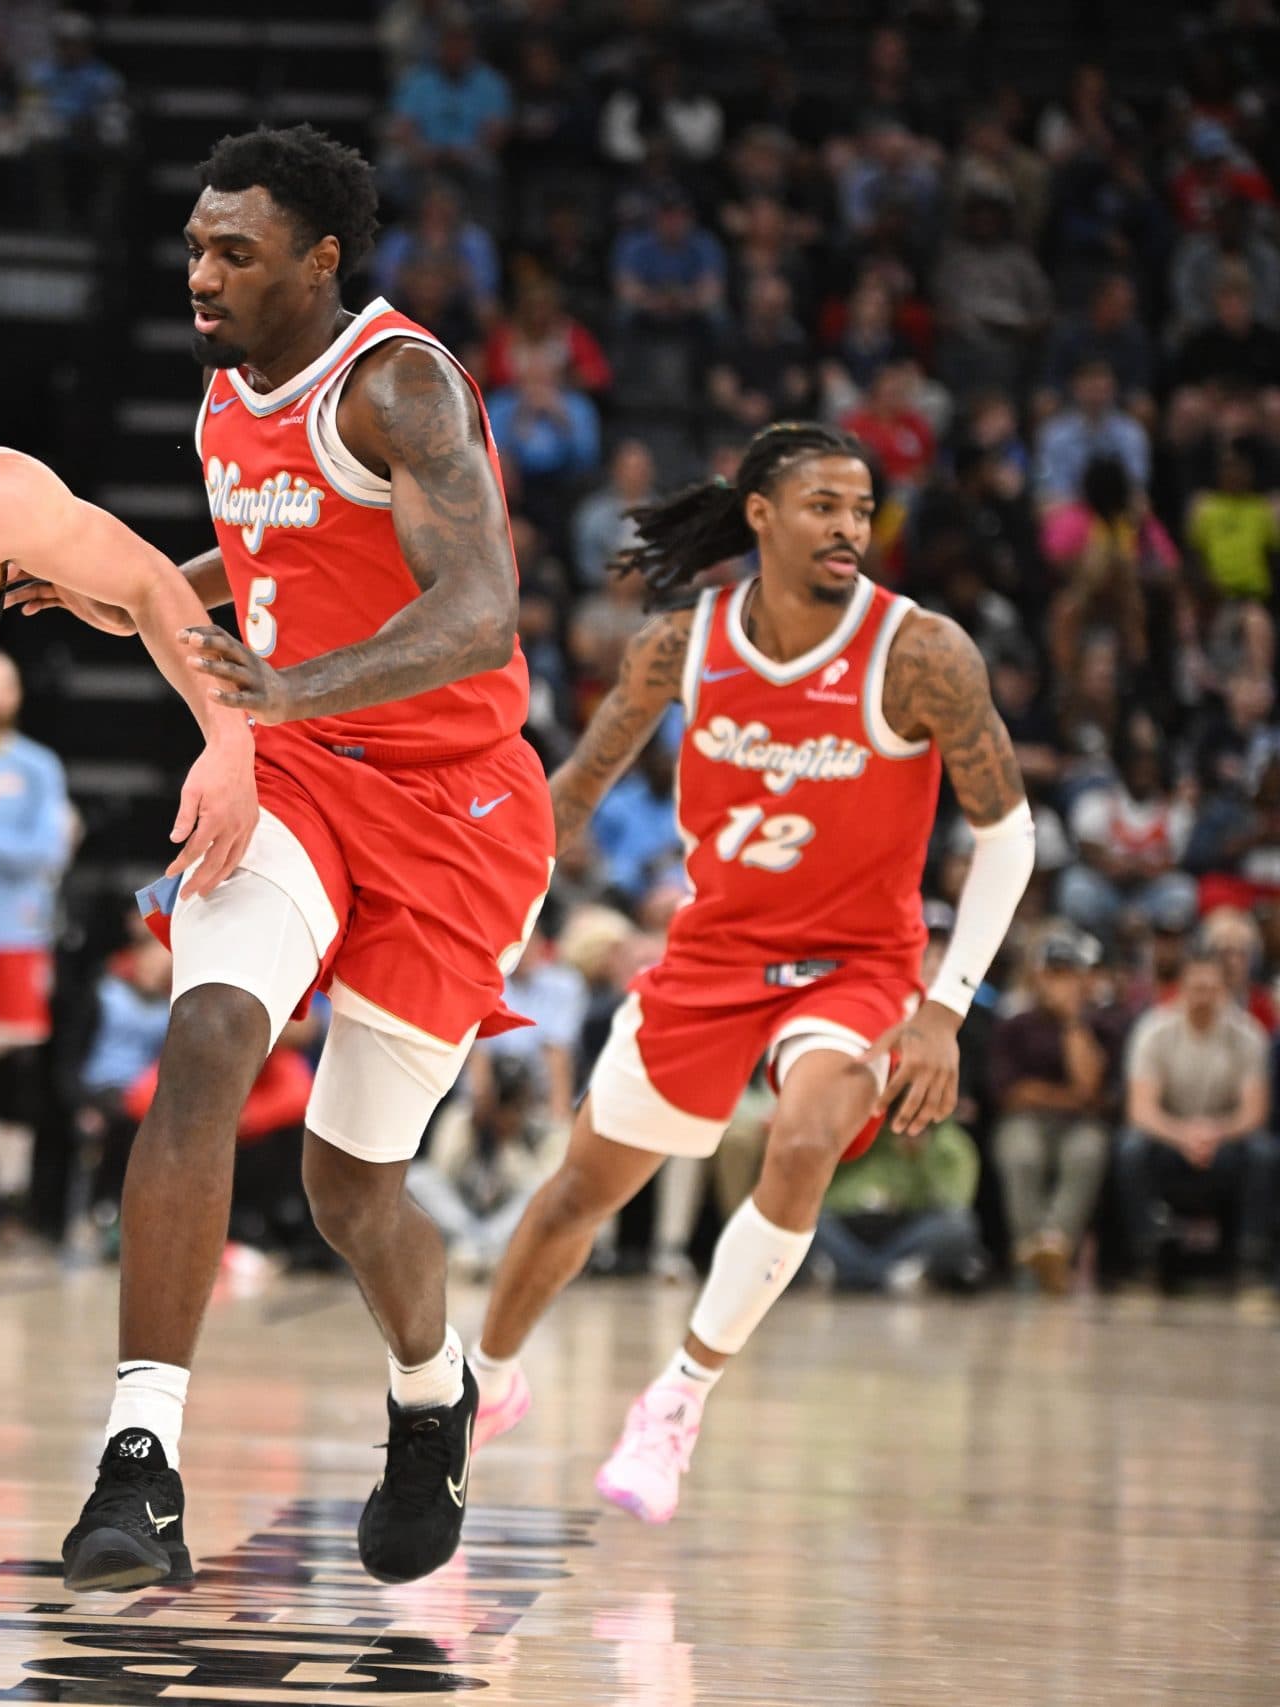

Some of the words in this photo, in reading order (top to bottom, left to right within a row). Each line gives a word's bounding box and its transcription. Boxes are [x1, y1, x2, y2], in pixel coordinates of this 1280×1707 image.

[205, 456, 325, 555] Memphis
[245, 576, 277, 659] 5
[693, 715, 873, 796] Memphis
[715, 803, 816, 872] 12
